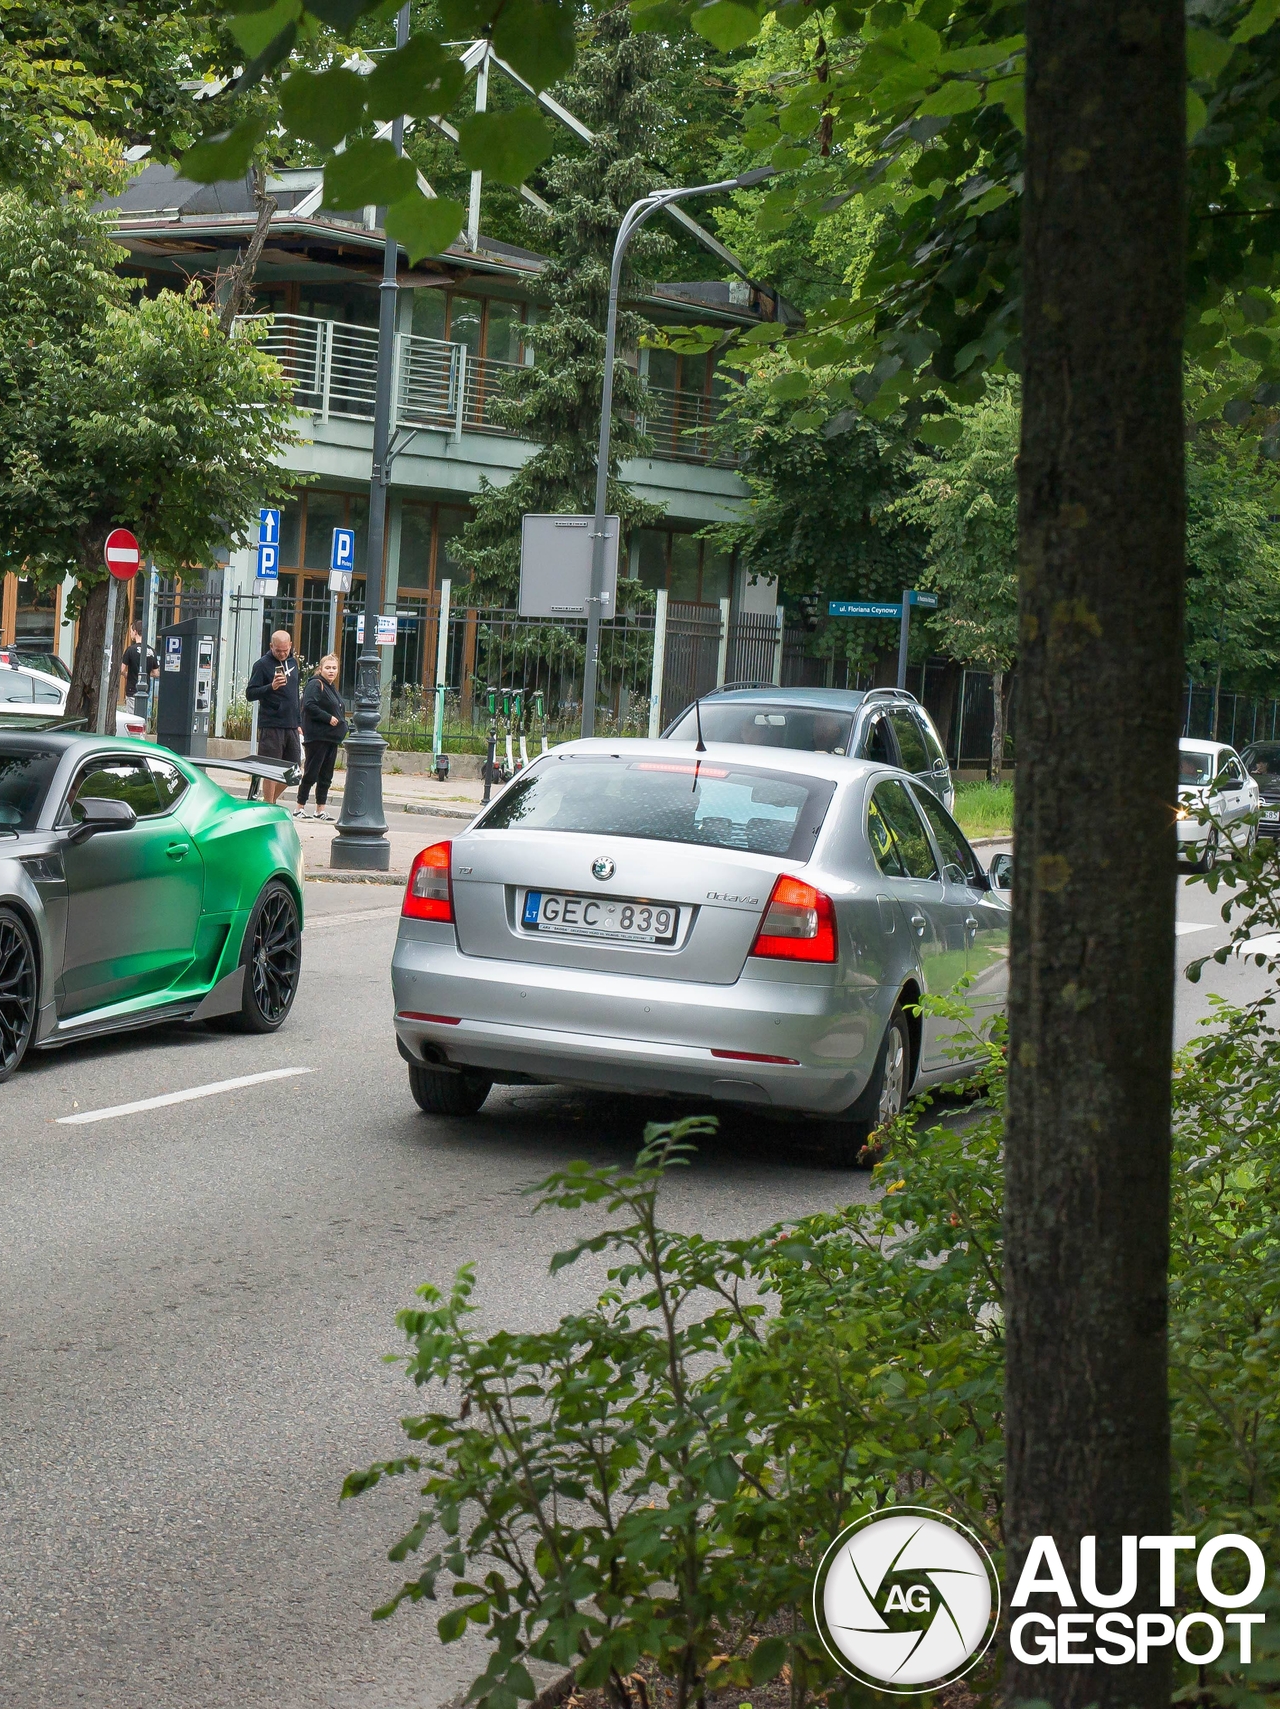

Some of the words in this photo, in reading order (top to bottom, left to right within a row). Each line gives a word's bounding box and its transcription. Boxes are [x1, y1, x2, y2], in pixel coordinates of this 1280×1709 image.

[337, 533, 351, 566] P
[262, 548, 275, 575] P
[871, 606, 898, 615] Ceynowy
[168, 638, 180, 653] P
[706, 891, 759, 905] Octavia
[525, 910, 537, 918] LT
[542, 897, 601, 926] GEC
[620, 905, 671, 934] 839
